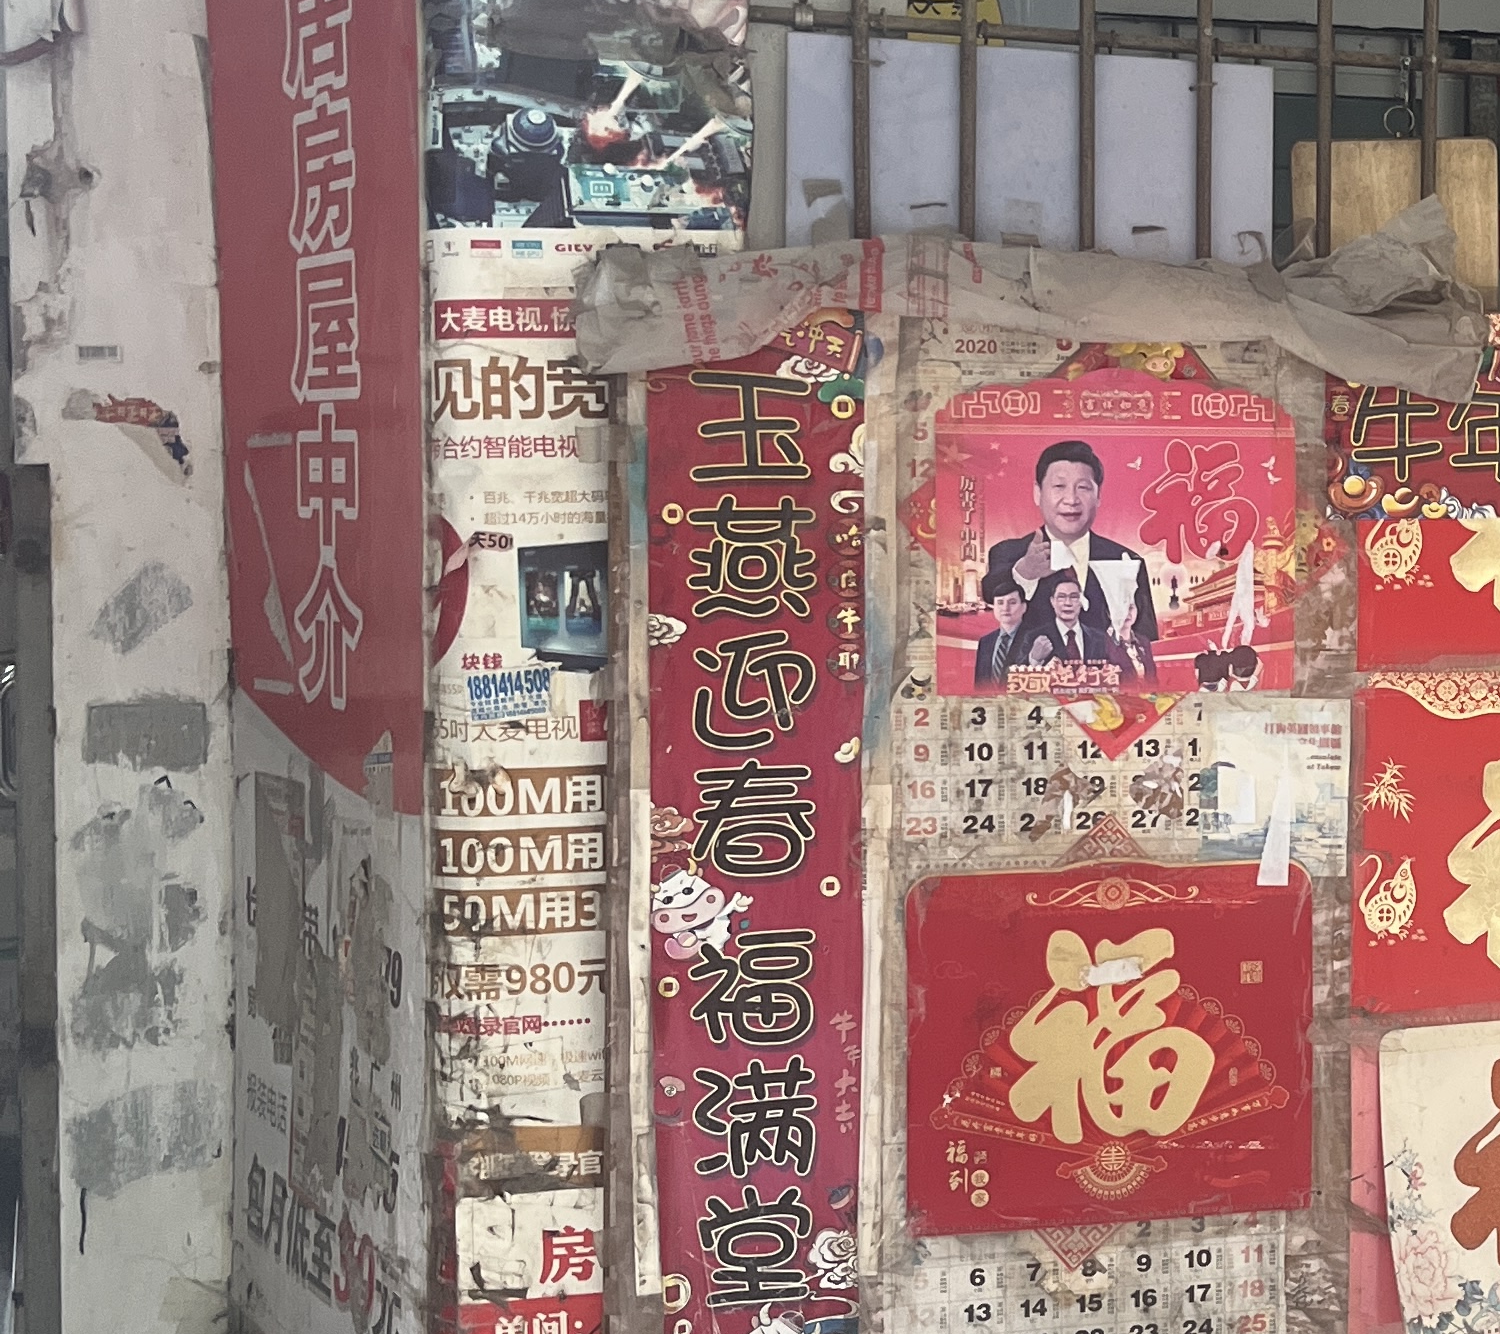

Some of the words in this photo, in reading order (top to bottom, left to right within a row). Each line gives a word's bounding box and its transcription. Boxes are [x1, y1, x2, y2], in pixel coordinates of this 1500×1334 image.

[954, 338, 998, 355] 2020
[1139, 437, 1260, 564] 福
[466, 666, 557, 701] 1881414508
[913, 707, 930, 728] 2
[970, 706, 987, 726] 3
[1027, 705, 1044, 725] 4
[913, 744, 930, 763] 9
[964, 742, 994, 762] 10
[1023, 741, 1048, 761] 11
[1133, 739, 1161, 758] 13
[906, 780, 936, 800] 16
[965, 778, 994, 798] 17
[1021, 777, 1048, 797] 18
[686, 369, 818, 1309] 玉燕迎春福满堂
[906, 816, 938, 836] 23
[962, 814, 996, 835] 24
[439, 829, 603, 875] 100M用
[1008, 927, 1216, 1145] 福
[945, 1139, 970, 1194] 福到
[539, 1225, 596, 1284] 房
[969, 1267, 986, 1288] 6
[1026, 1262, 1043, 1283] 7
[1081, 1258, 1098, 1278] 8
[1136, 1253, 1153, 1273] 9
[1183, 1248, 1212, 1269] 10
[1239, 1244, 1264, 1264] 11
[964, 1302, 992, 1324] 13
[1019, 1298, 1048, 1319] 14
[1075, 1293, 1104, 1314] 15
[1129, 1288, 1158, 1309] 16
[1184, 1283, 1212, 1304] 17
[1237, 1278, 1265, 1299] 18
[1237, 1313, 1268, 1334] 25
